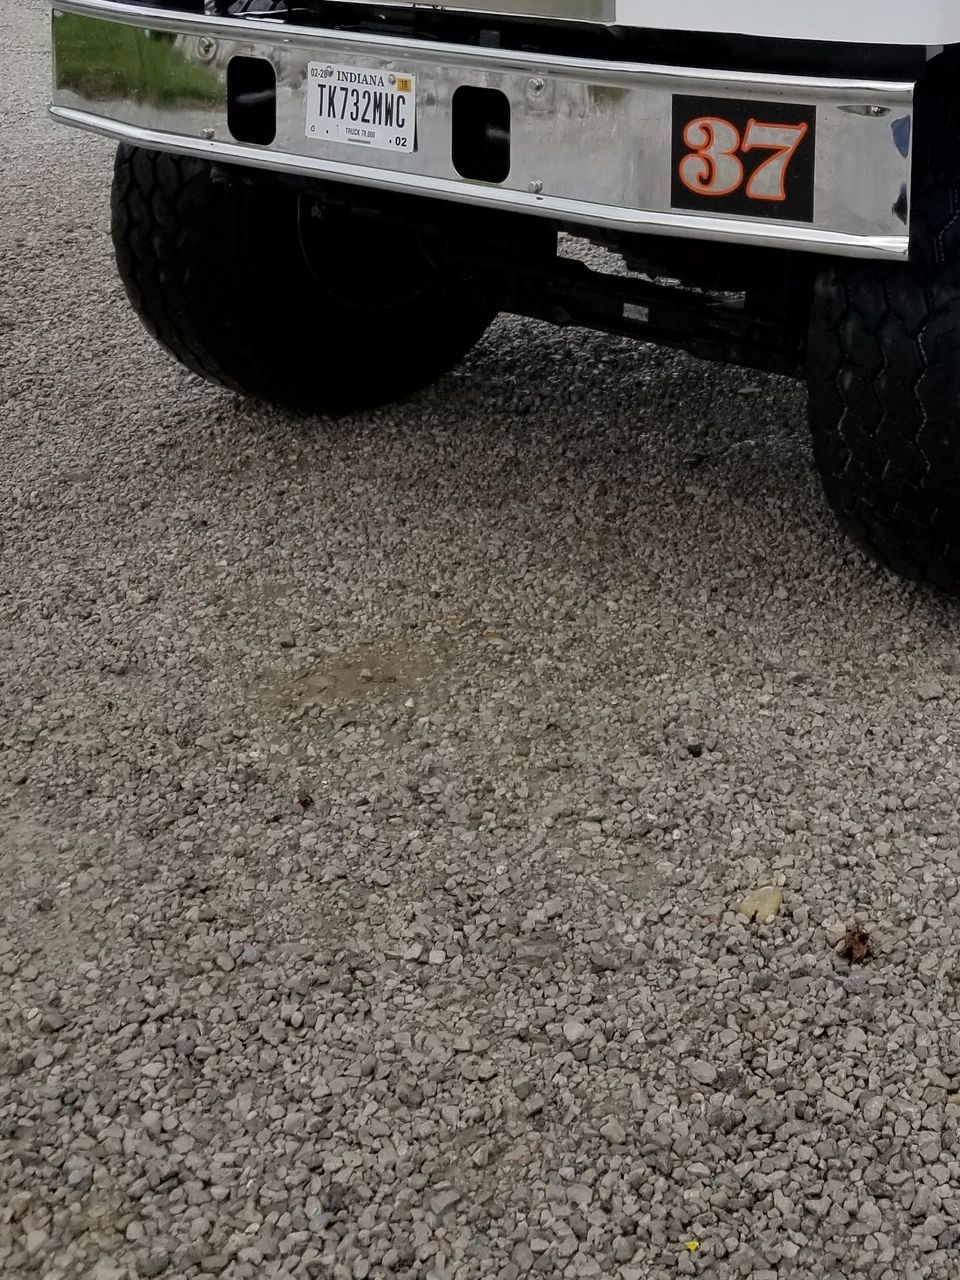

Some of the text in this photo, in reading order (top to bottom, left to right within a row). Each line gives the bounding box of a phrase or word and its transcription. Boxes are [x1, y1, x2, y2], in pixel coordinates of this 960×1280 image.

[336, 70, 385, 87] INDIANA
[317, 83, 406, 128] TK732MWC
[395, 136, 407, 147] 02
[678, 116, 808, 201] 37
